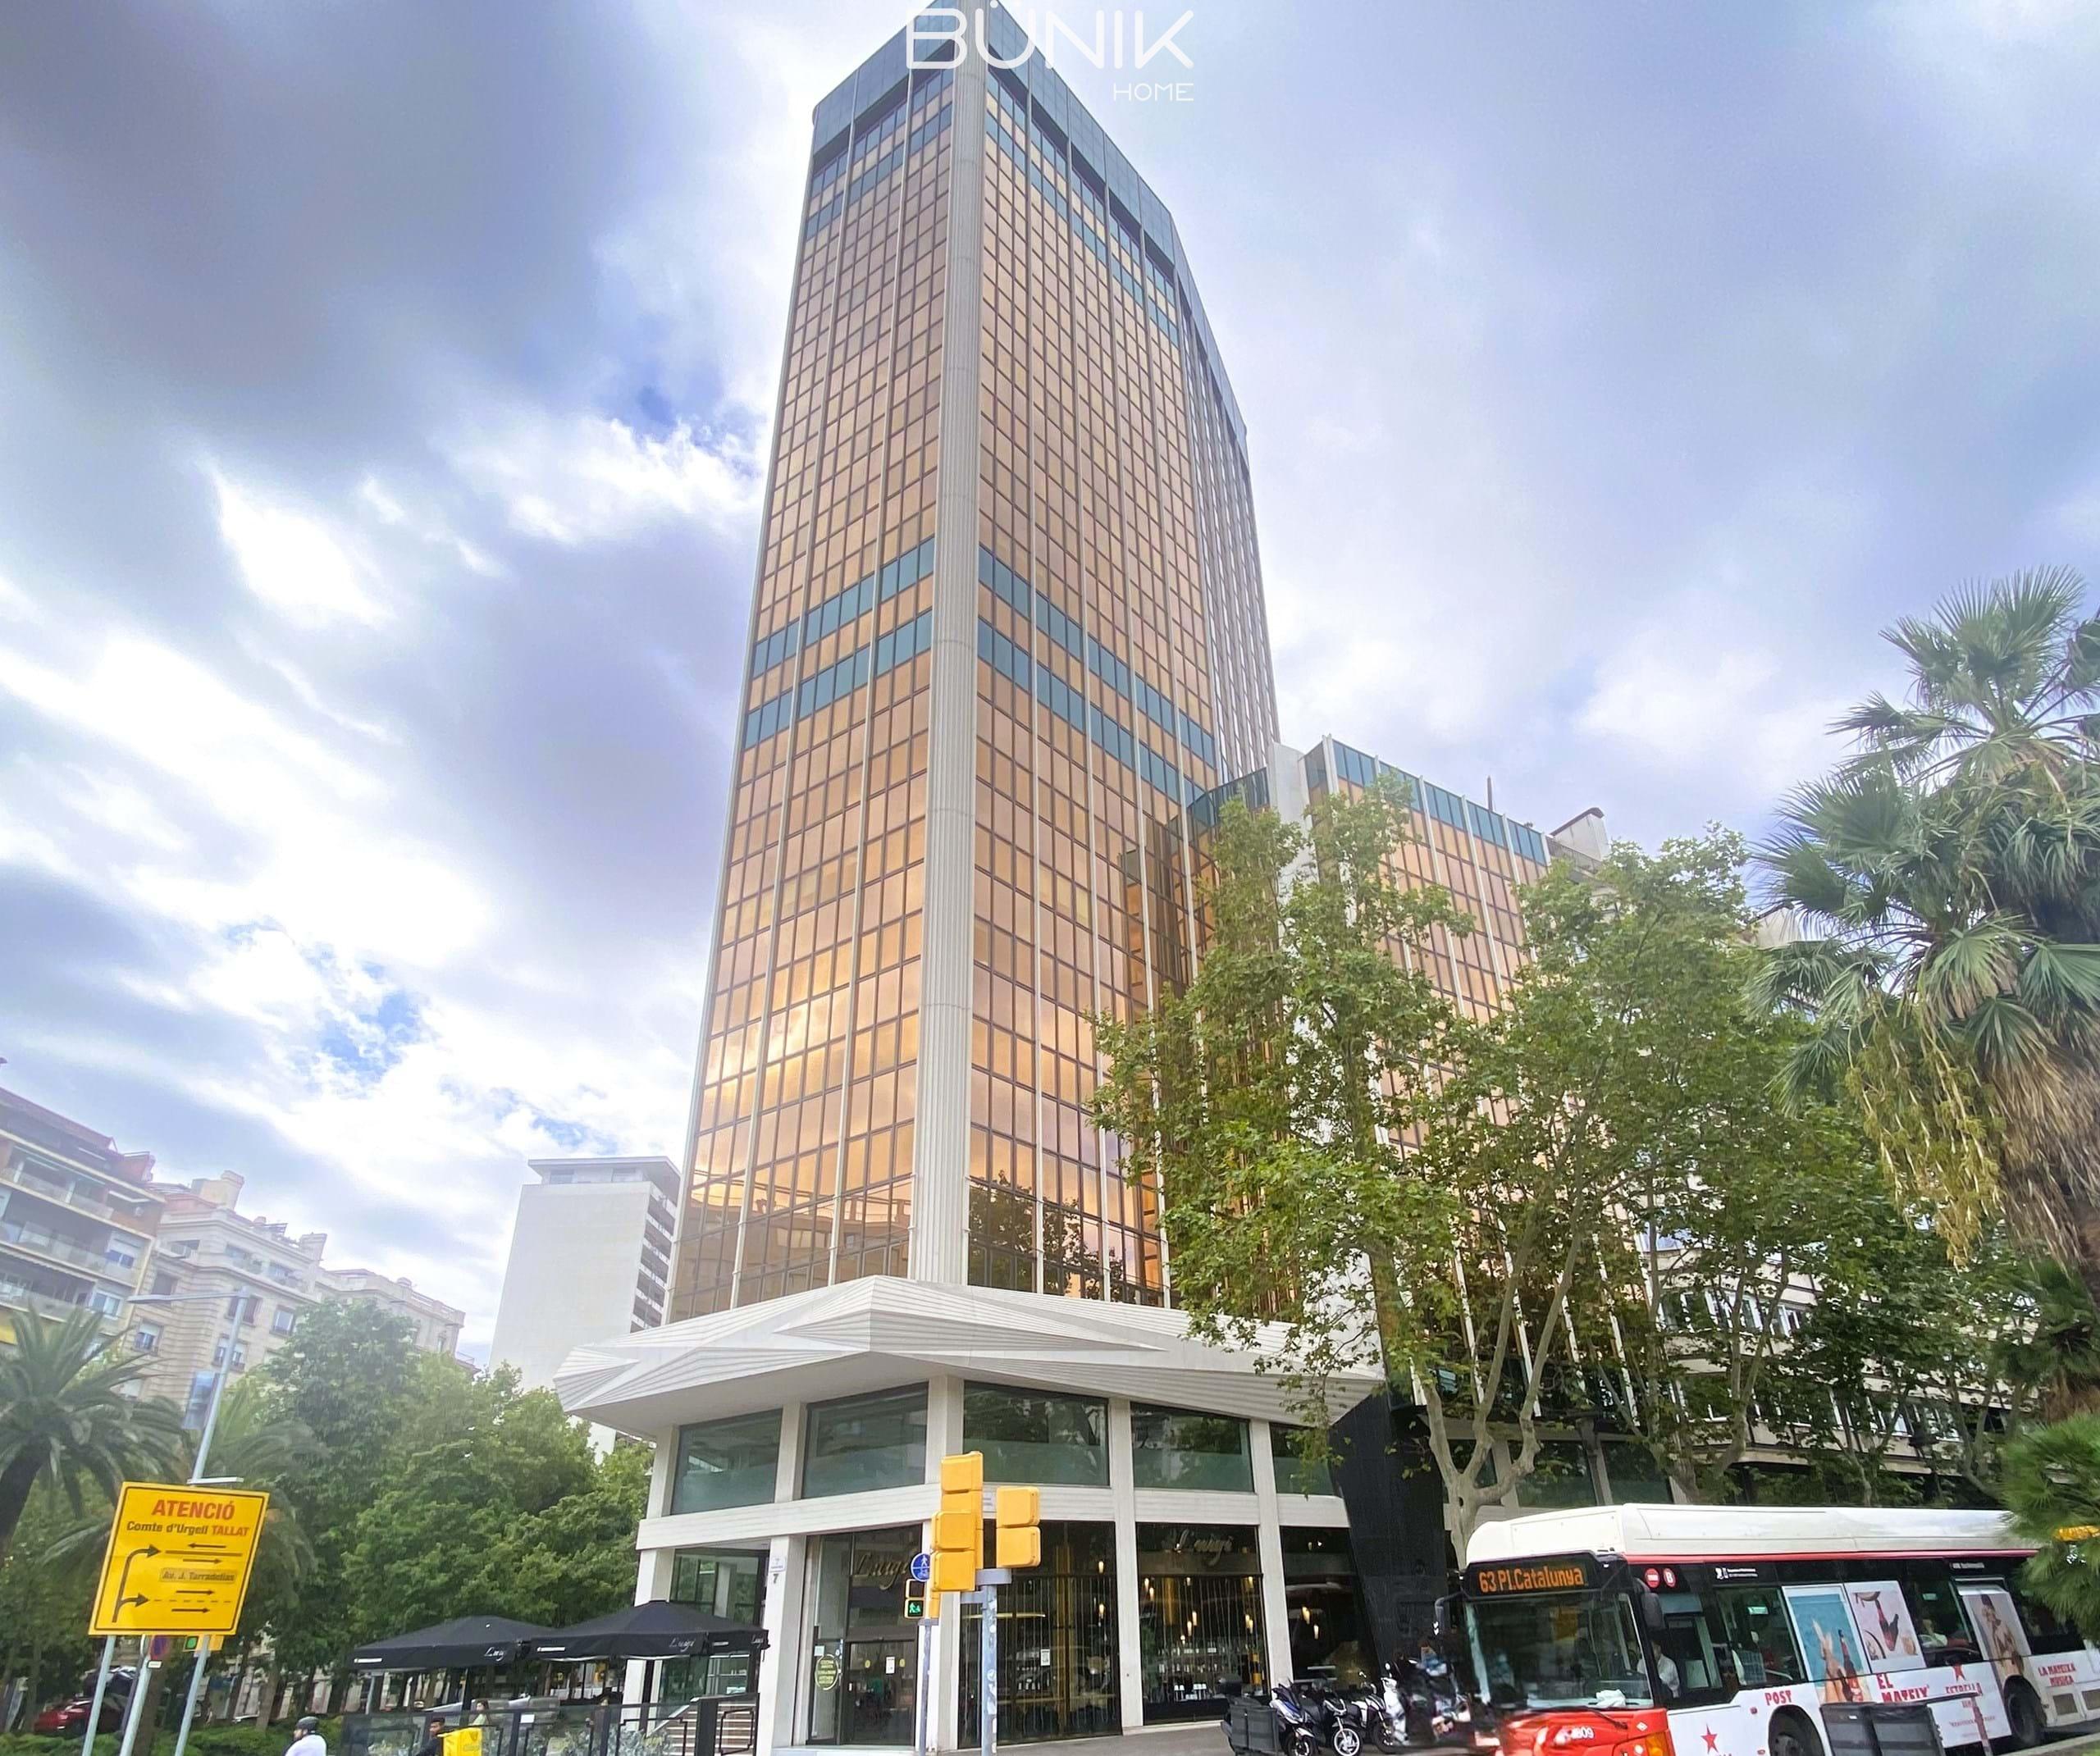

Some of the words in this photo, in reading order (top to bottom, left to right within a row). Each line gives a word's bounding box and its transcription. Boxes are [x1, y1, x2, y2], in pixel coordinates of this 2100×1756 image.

[152, 1499, 235, 1520] ATENCIÓ
[126, 1521, 163, 1533] Comte
[166, 1522, 208, 1536] d'Urgell
[212, 1525, 250, 1537] TALLAT
[773, 1573, 779, 1584] 7
[1478, 1570, 1497, 1593] 63
[1876, 1672, 1893, 1689] EL
